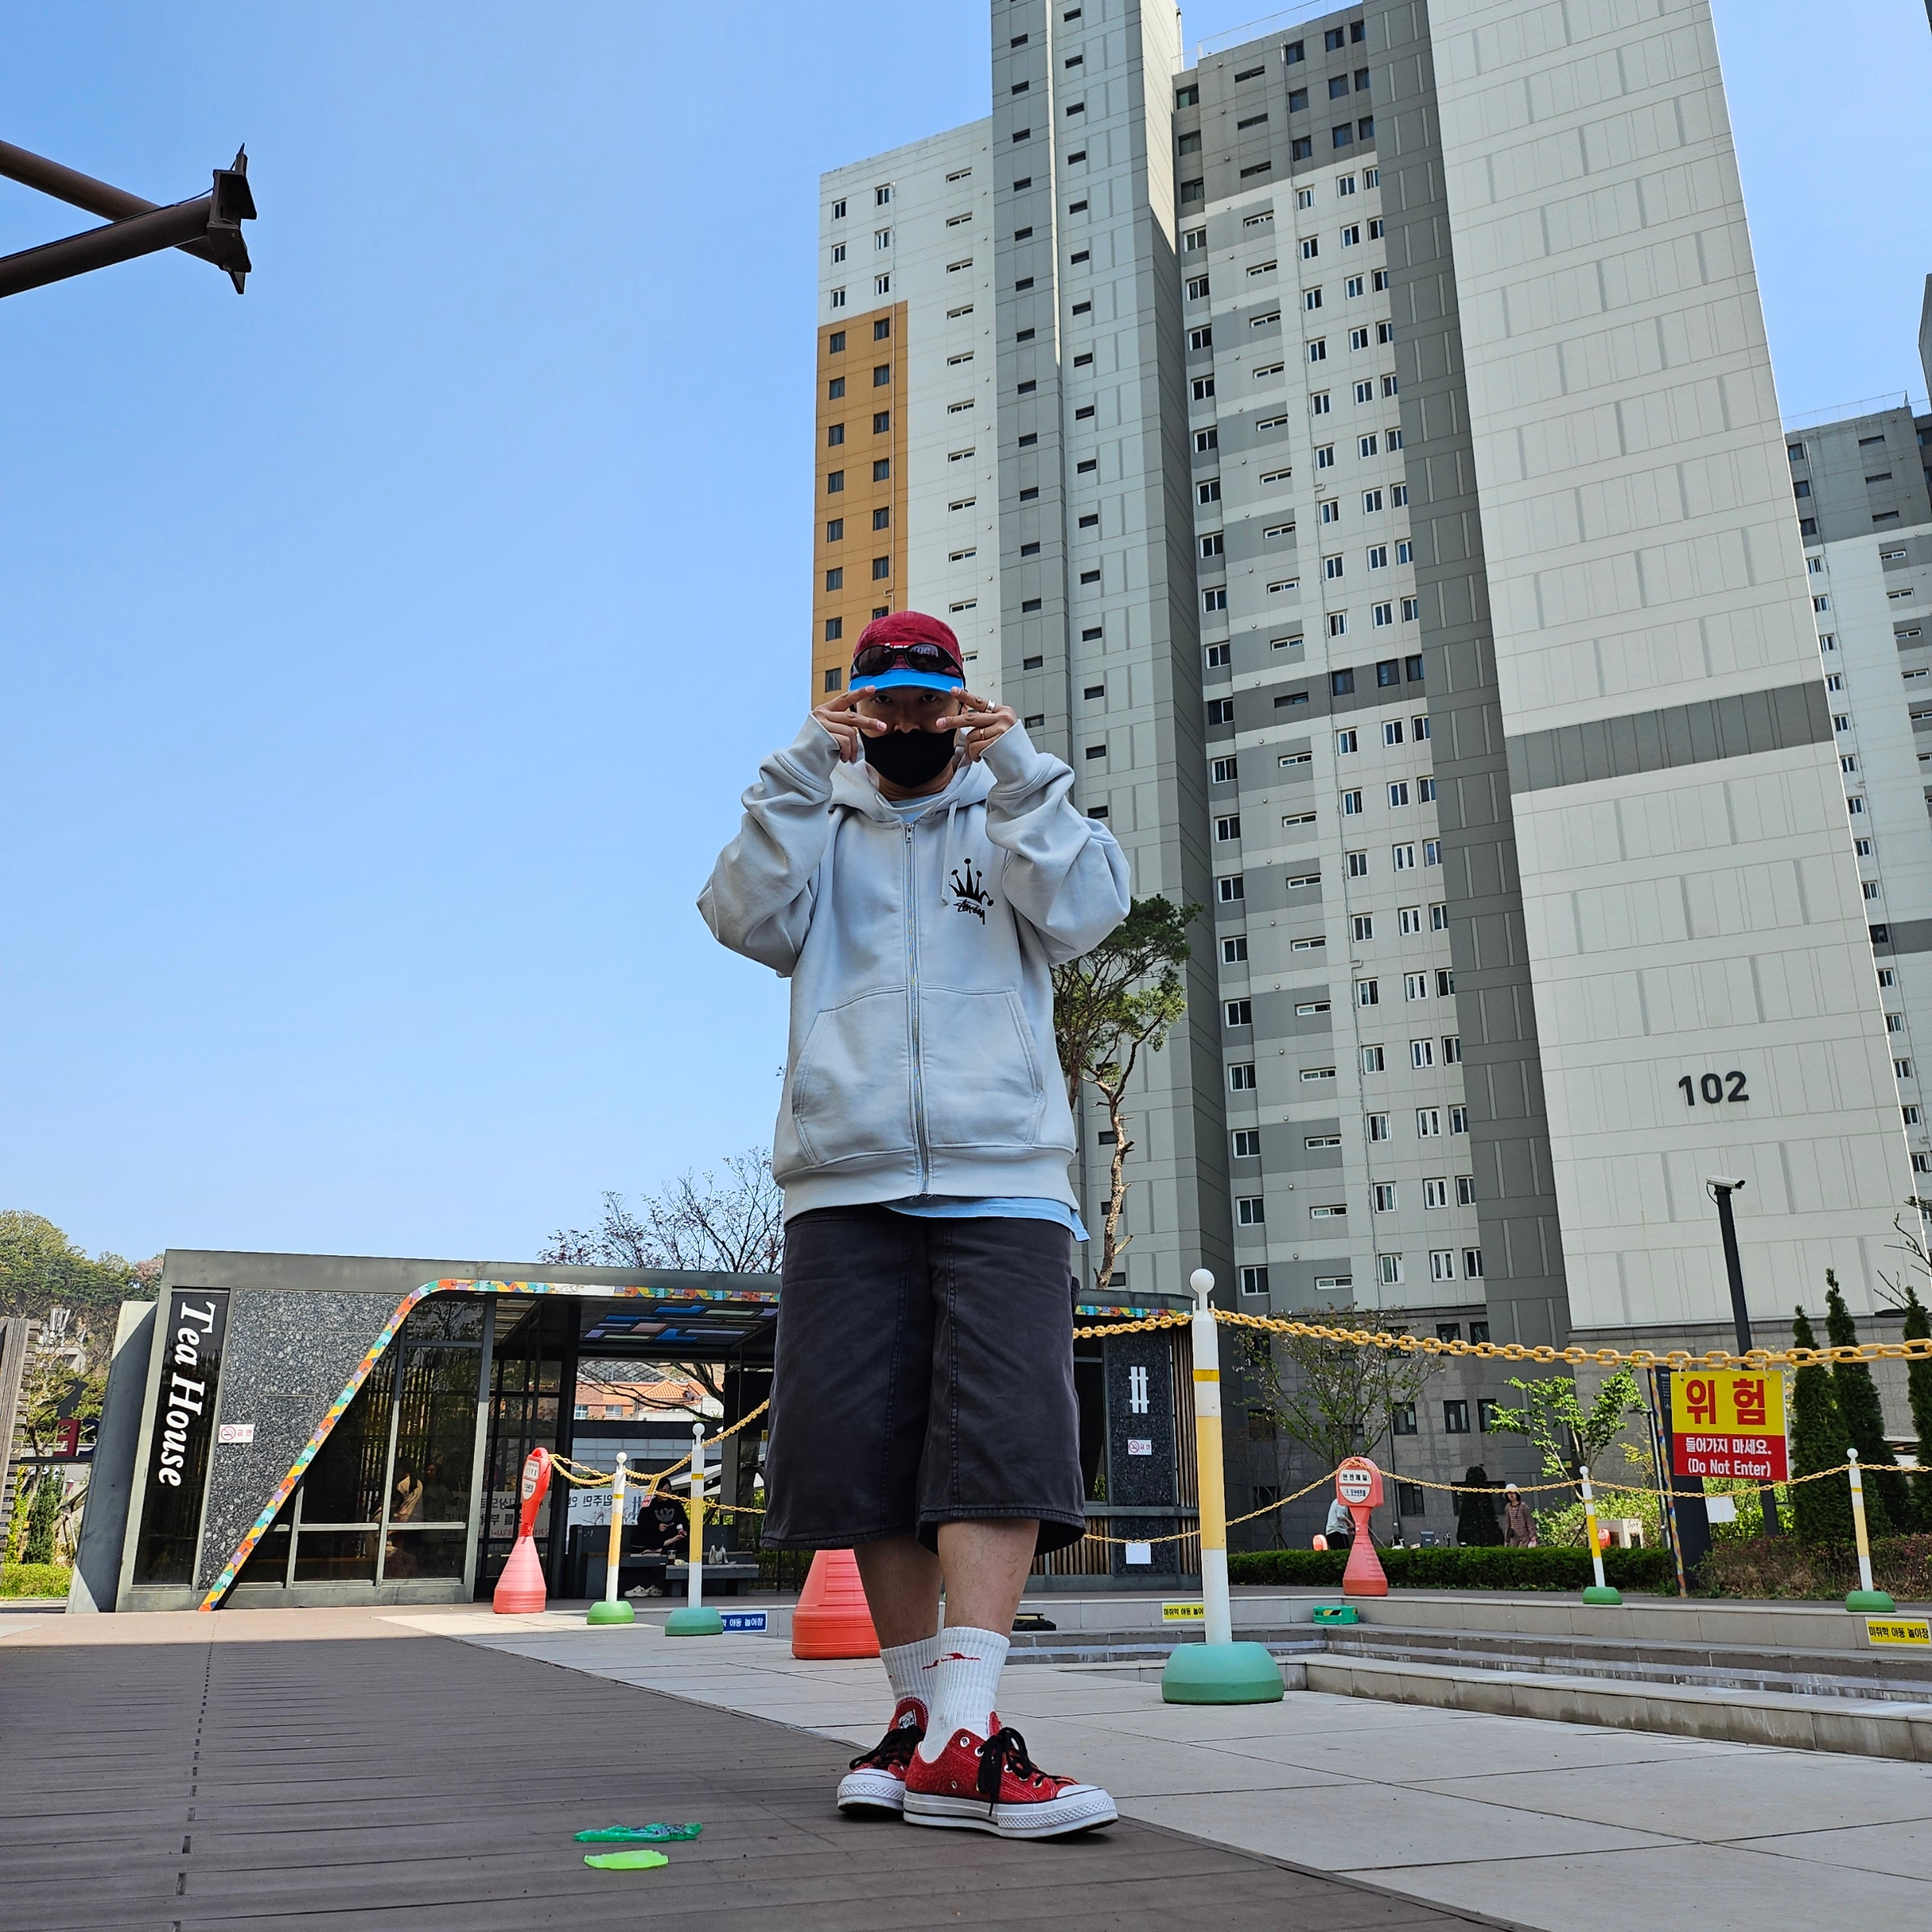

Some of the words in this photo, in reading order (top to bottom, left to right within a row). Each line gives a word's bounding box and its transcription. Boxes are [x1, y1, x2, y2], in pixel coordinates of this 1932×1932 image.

[1679, 1071, 1749, 1106] 102
[175, 1301, 216, 1366] Tea
[159, 1372, 205, 1487] House
[1686, 1437, 1728, 1453] 들어가지
[1732, 1439, 1772, 1454] 마세요.
[1688, 1458, 1706, 1473] (Do
[1710, 1460, 1730, 1474] Not
[1734, 1460, 1771, 1477] Enter)
[729, 1618, 742, 1627] 아동
[745, 1618, 764, 1627] 놀이장
[1869, 1626, 1889, 1637] 미취학
[1891, 1627, 1905, 1638] 아동
[1908, 1628, 1929, 1639] 놀이장
